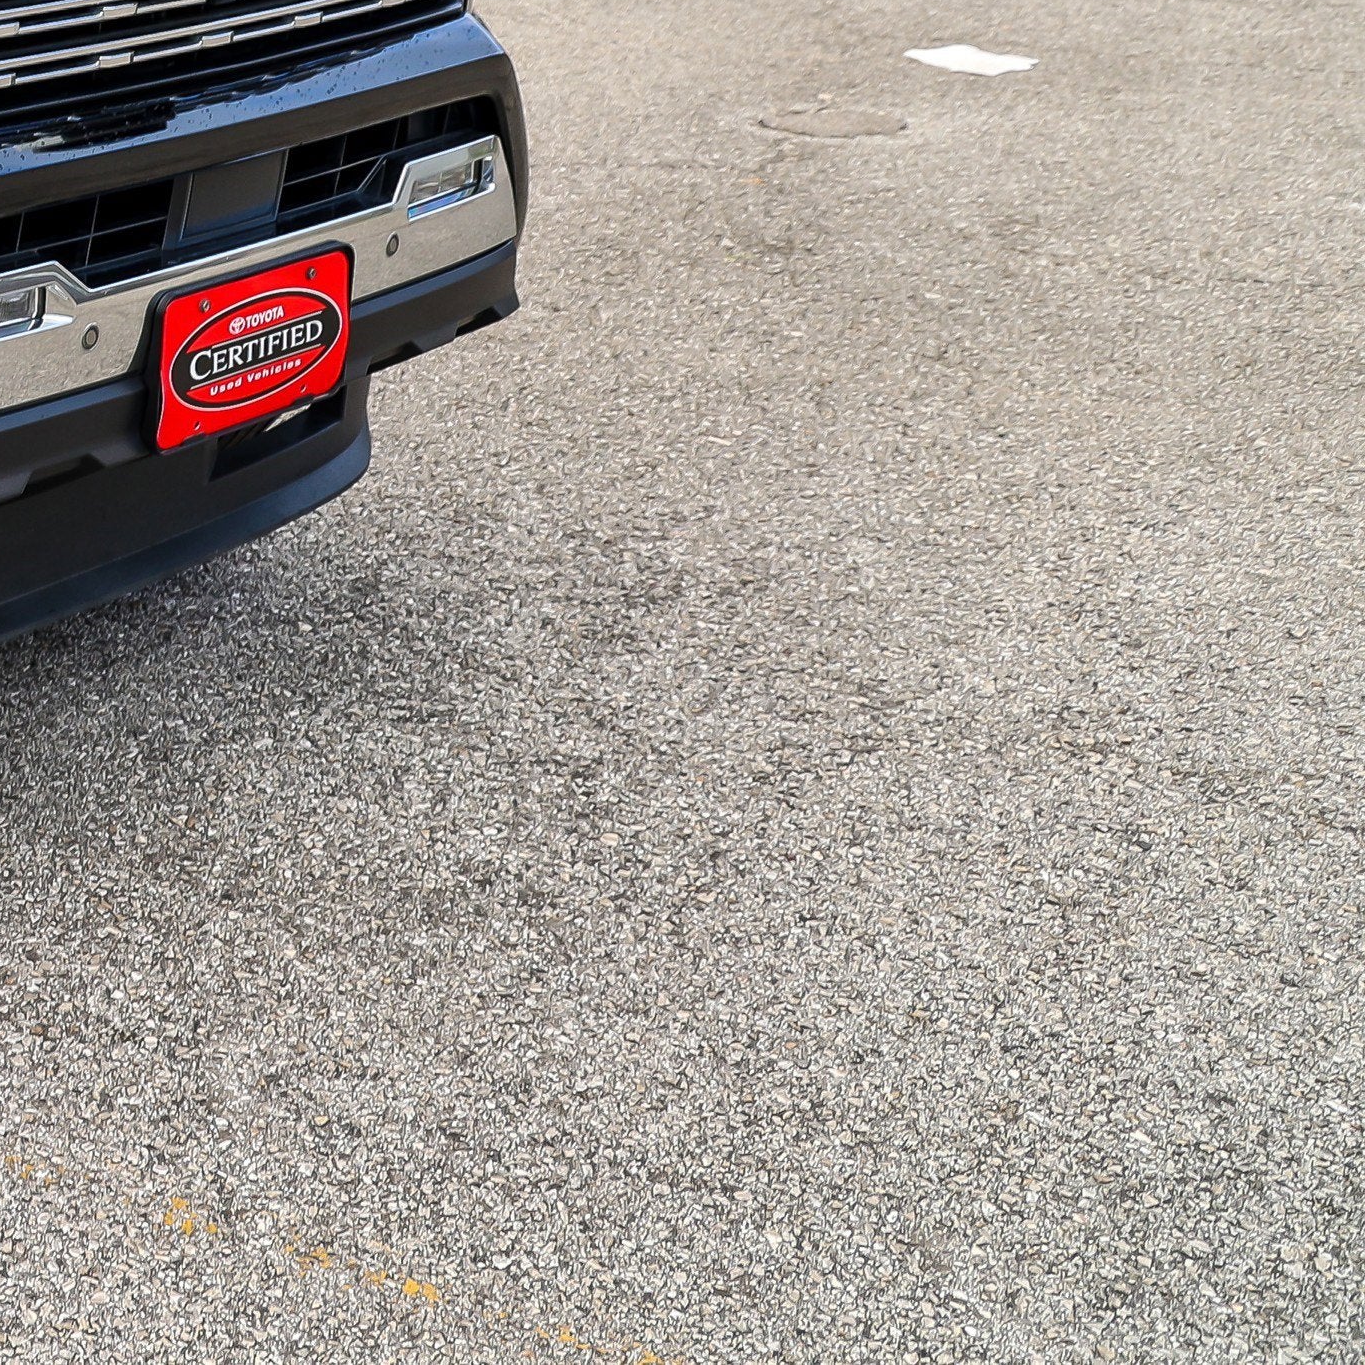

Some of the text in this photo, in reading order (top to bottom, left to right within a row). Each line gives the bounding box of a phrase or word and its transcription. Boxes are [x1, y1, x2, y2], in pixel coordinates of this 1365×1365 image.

[245, 306, 284, 329] TOYOTA
[189, 320, 323, 381] CERTIFIED
[210, 358, 302, 396] Used Vehicles
